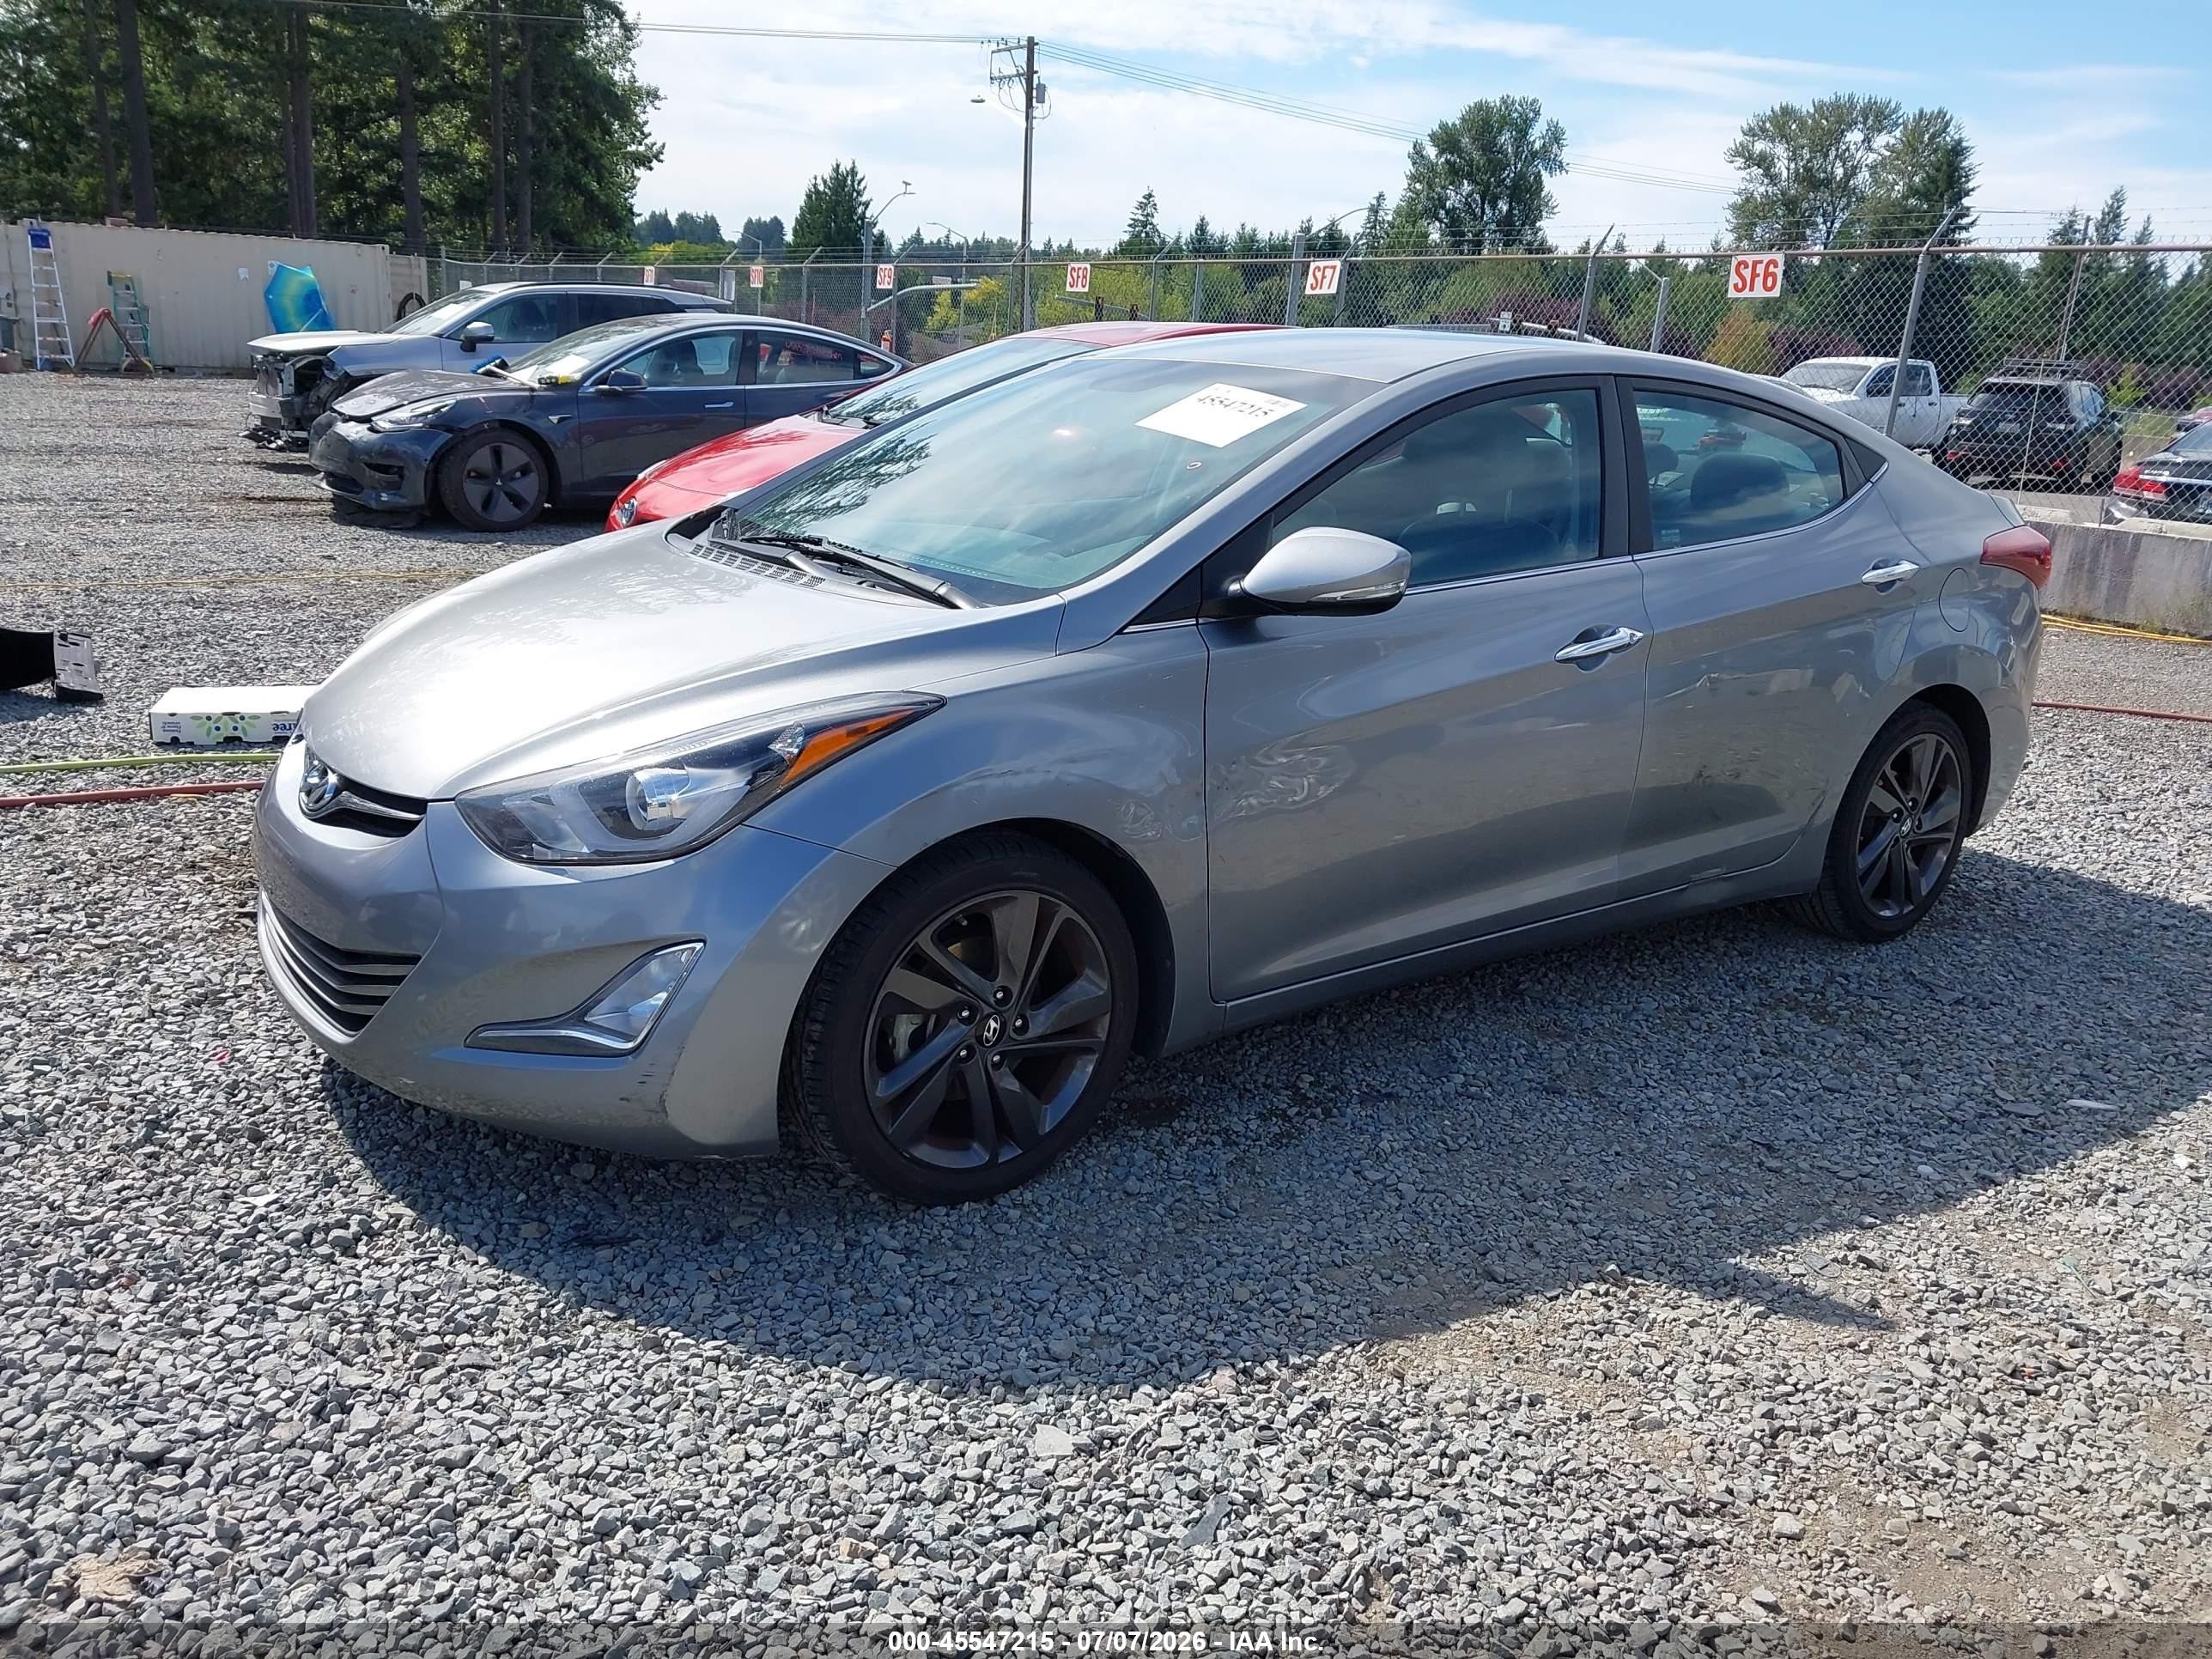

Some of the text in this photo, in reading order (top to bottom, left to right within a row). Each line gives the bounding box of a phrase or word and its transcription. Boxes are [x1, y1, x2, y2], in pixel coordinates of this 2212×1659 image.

[751, 268, 763, 285] SF10
[878, 267, 892, 286] SF9
[1068, 266, 1088, 289] SF8
[1310, 264, 1338, 291] SF7
[1733, 258, 1779, 293] SF6
[1197, 394, 1276, 417] 45547215
